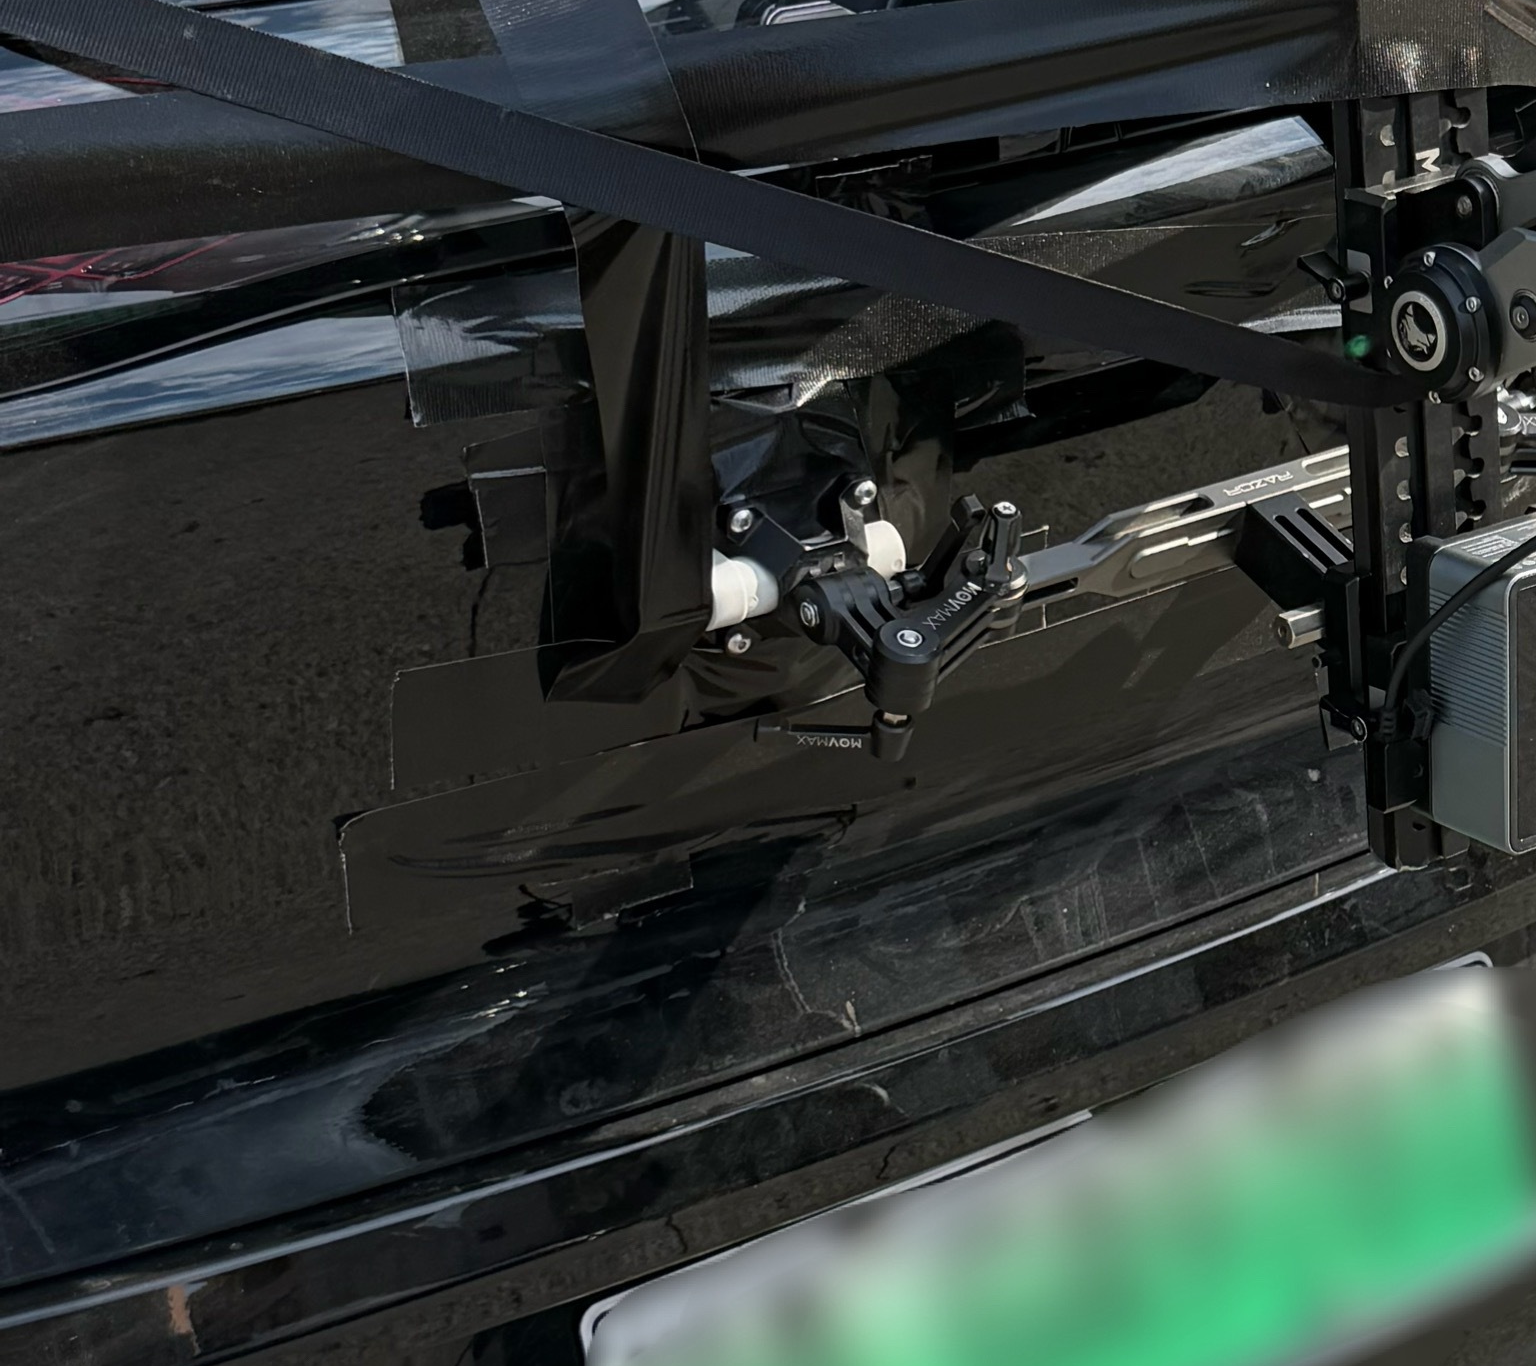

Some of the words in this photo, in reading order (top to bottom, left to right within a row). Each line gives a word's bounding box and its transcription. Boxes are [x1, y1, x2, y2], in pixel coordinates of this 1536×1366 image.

[1222, 470, 1294, 497] RAZOR
[921, 581, 983, 631] MOVMAX
[796, 735, 863, 749] MOVMAX
